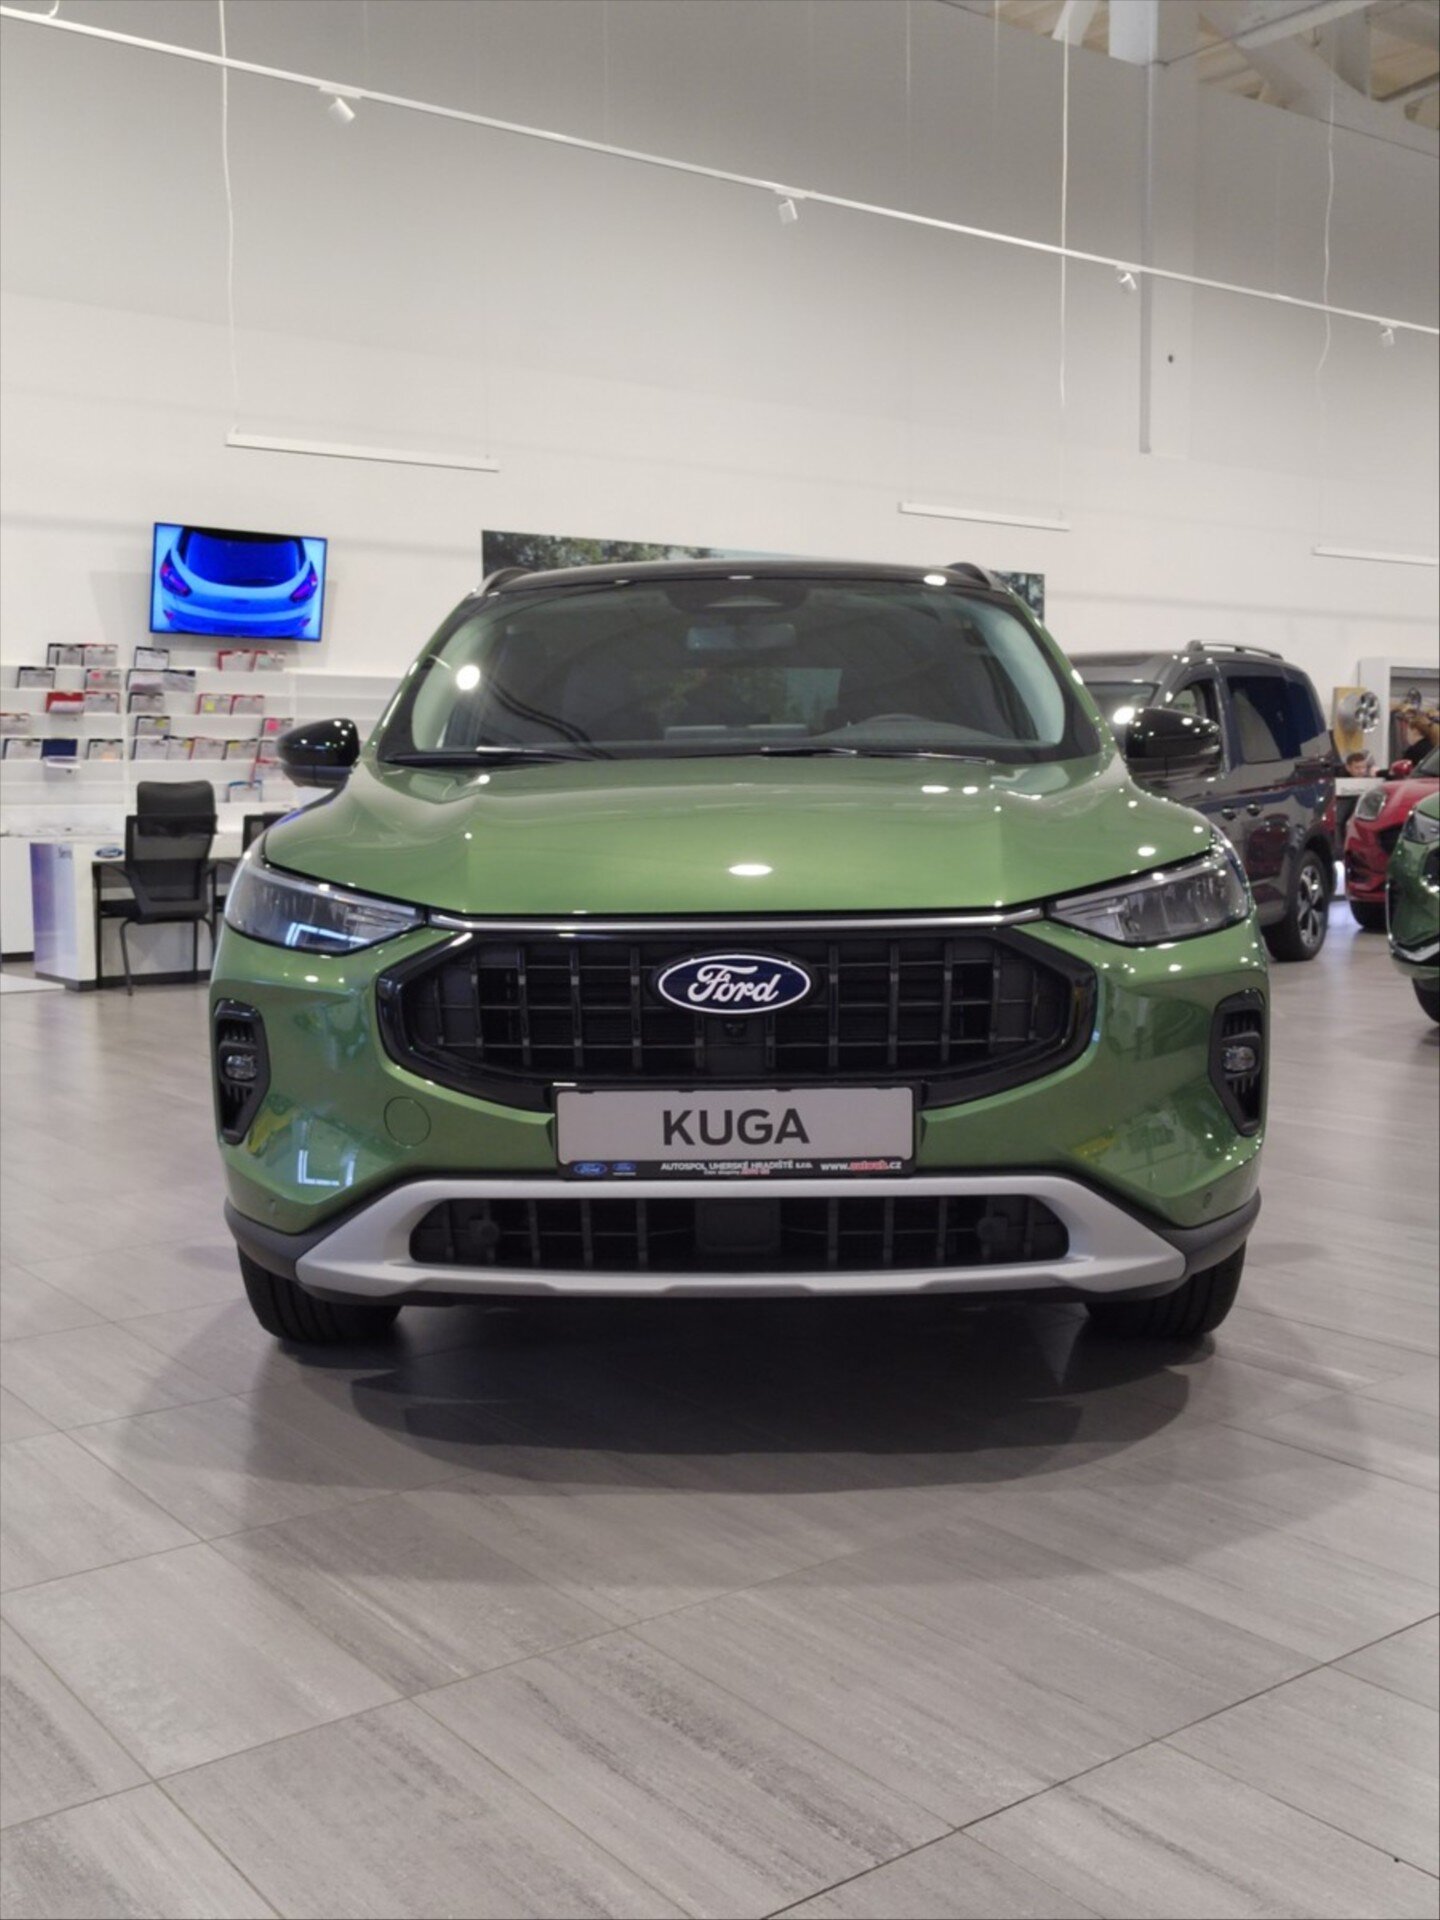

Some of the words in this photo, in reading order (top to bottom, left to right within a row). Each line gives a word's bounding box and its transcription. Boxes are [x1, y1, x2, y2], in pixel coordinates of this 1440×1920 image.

[687, 963, 781, 1002] Ford
[662, 1107, 810, 1146] KUGA
[660, 1161, 708, 1171] AUTOSPOL
